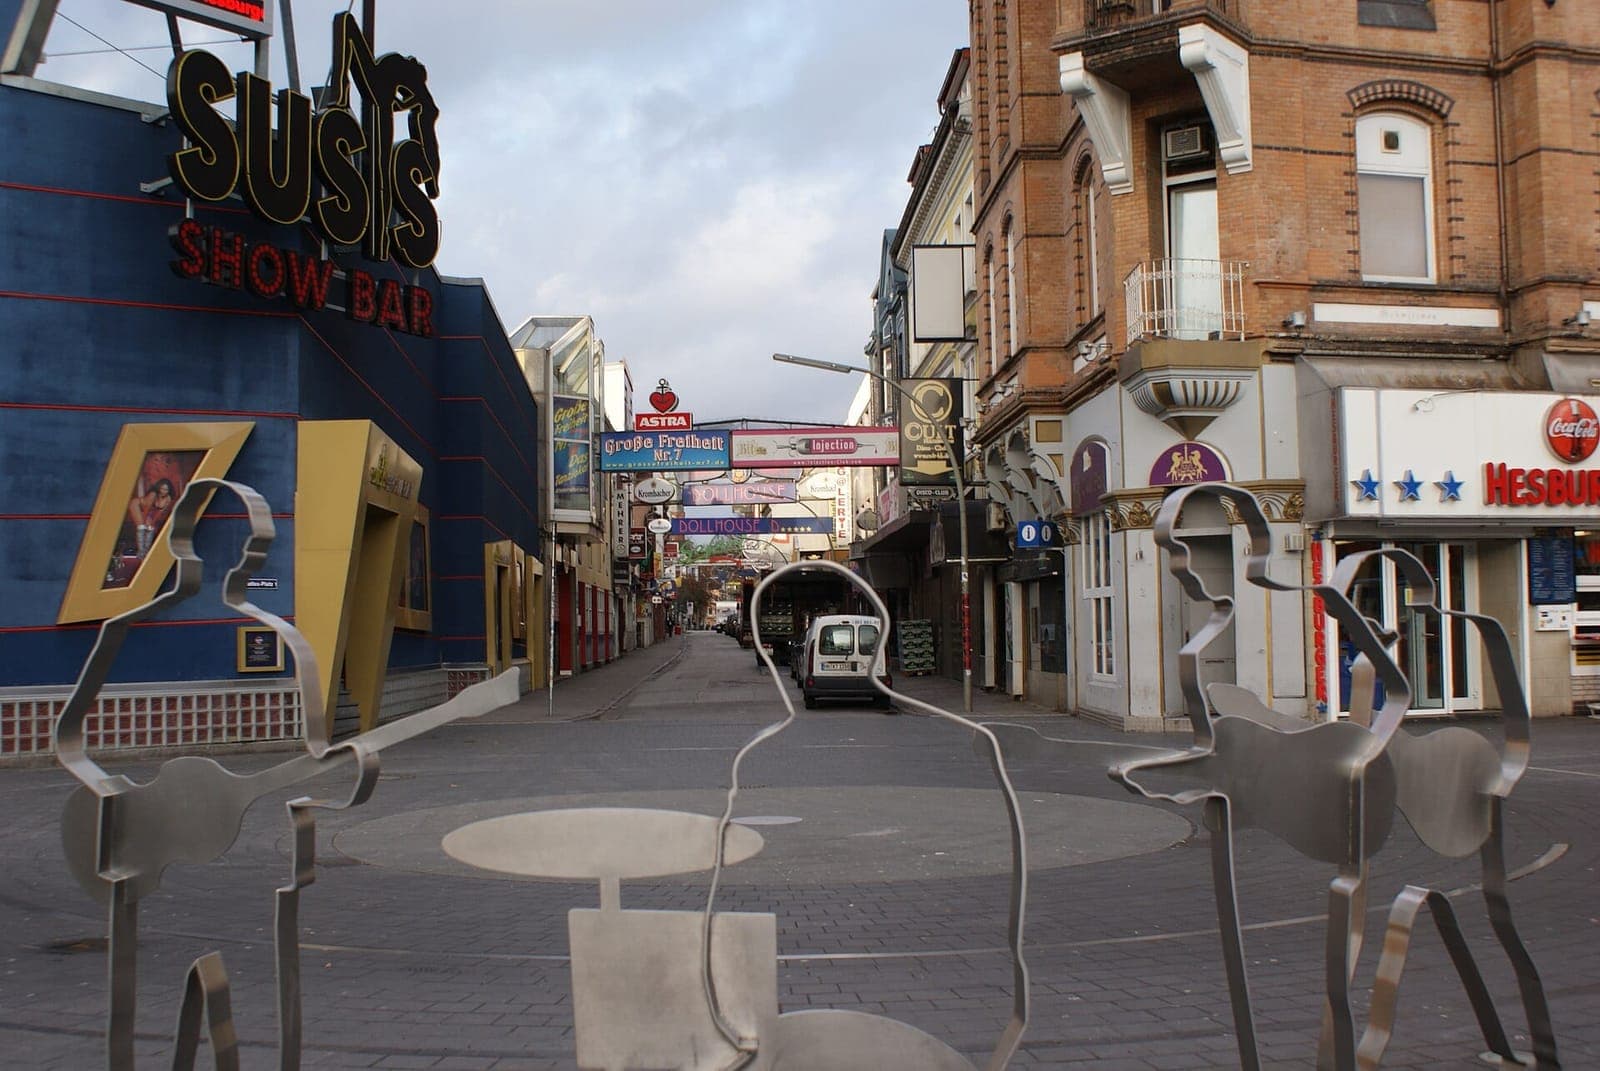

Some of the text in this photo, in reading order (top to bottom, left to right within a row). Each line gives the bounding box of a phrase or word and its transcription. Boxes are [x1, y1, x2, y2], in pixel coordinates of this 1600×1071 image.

[174, 218, 435, 339] SHOW BAR
[639, 416, 688, 427] ASTRA
[1548, 417, 1599, 438] Coca-Cola
[605, 435, 654, 456] Große
[658, 434, 725, 450] Freiheit
[811, 439, 855, 453] Injection
[638, 488, 671, 498] Krombacher
[679, 519, 761, 534] DOLLHOUSE
